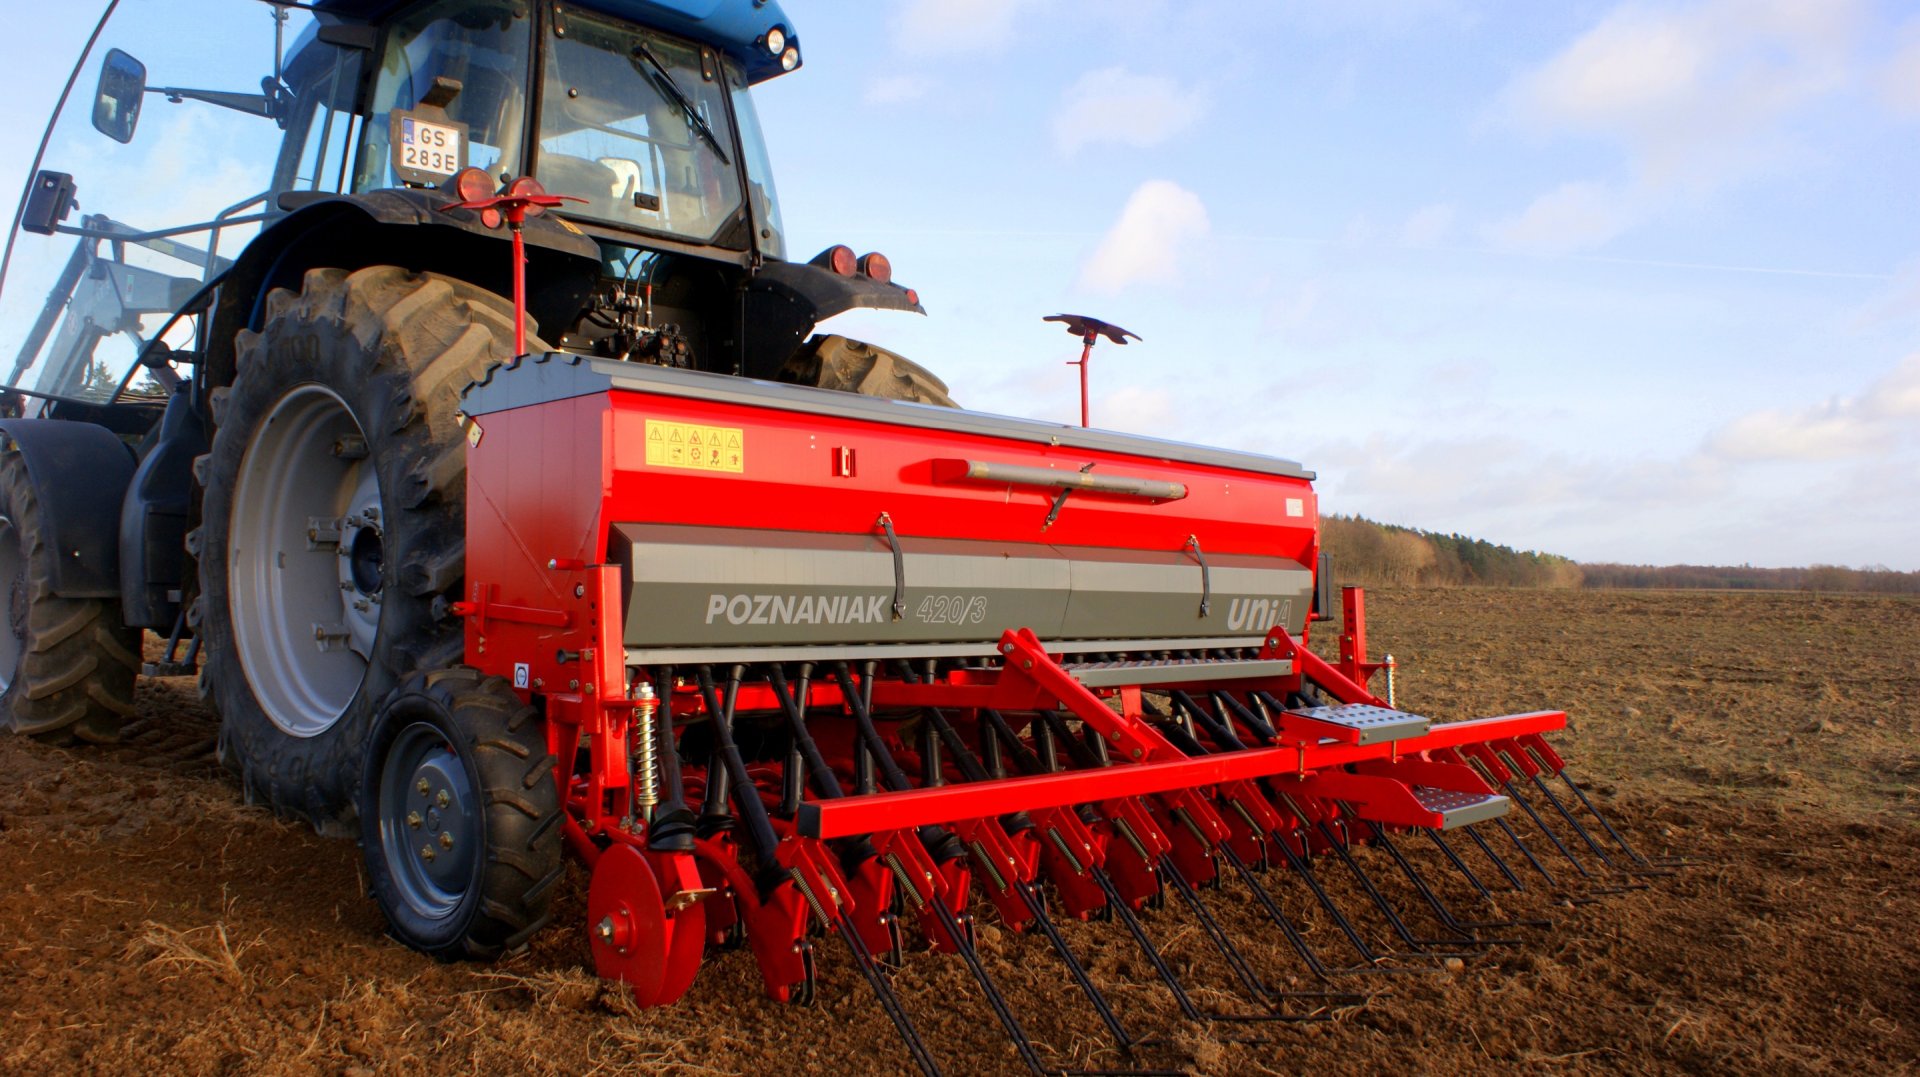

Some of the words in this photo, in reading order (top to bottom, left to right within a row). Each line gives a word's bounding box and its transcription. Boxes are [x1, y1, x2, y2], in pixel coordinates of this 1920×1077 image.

[421, 128, 445, 147] GS
[406, 147, 455, 172] 283E
[705, 594, 888, 624] POZNANIAK
[916, 595, 988, 625] 420/3
